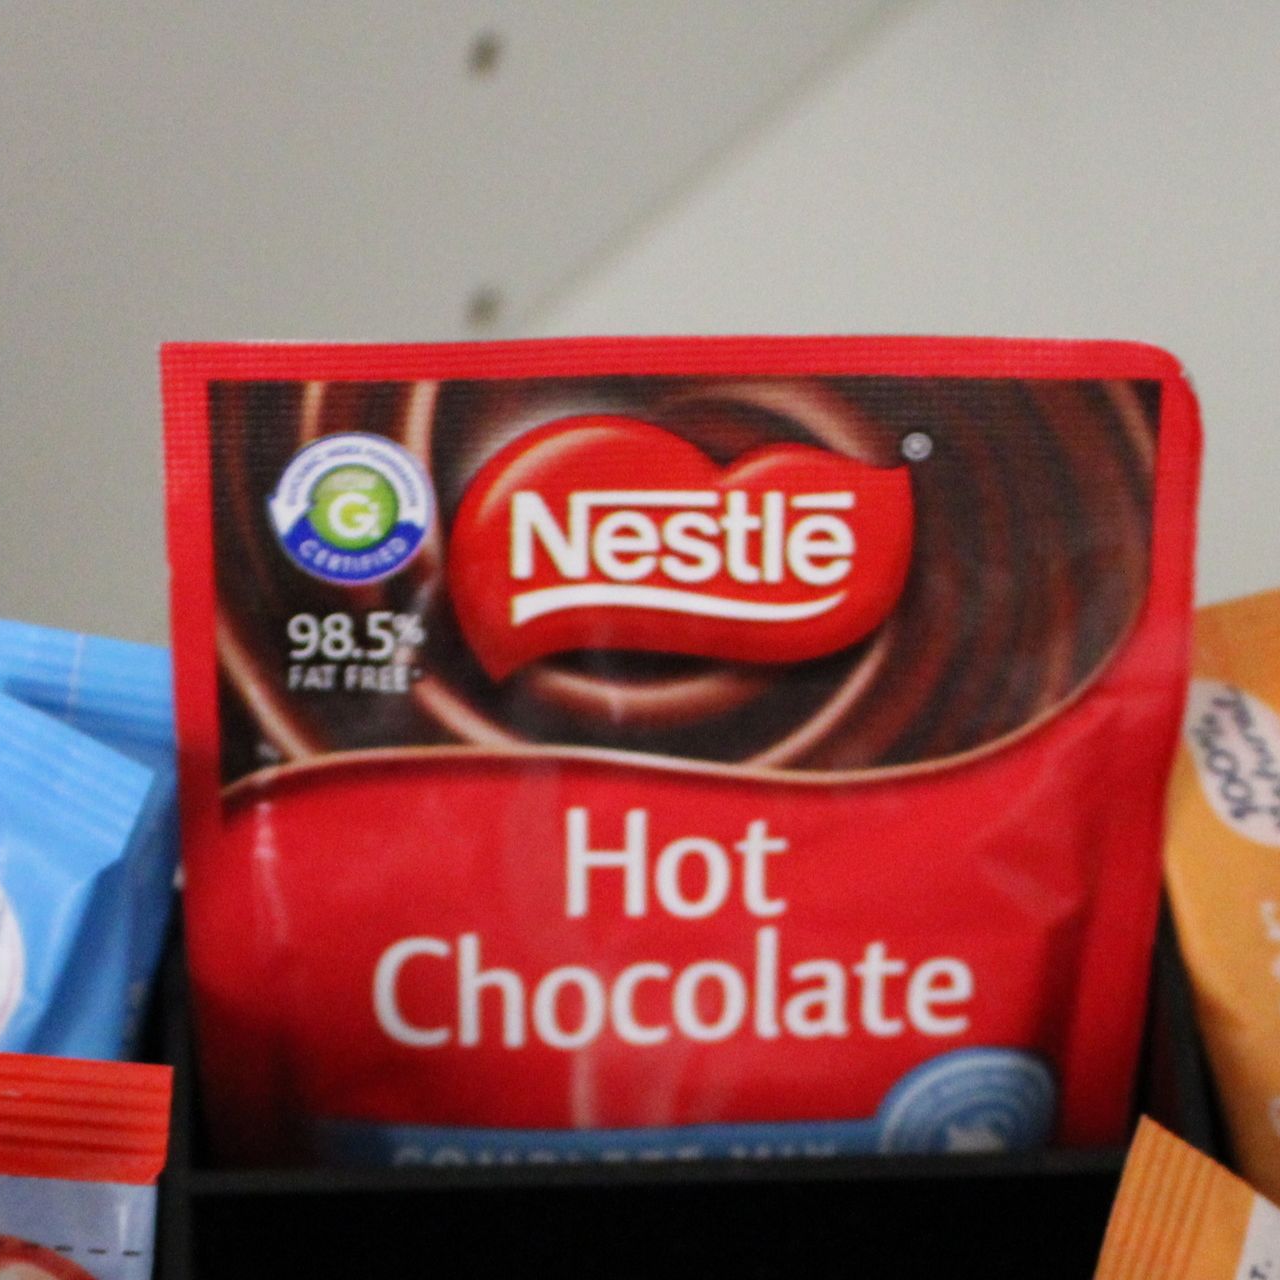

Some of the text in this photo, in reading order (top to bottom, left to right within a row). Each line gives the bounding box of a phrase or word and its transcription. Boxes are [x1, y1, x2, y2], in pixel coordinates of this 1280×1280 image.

[287, 611, 426, 659] 98.5%
[288, 664, 336, 689] FAT
[1191, 712, 1258, 820] 100%
[565, 807, 788, 920] Hot
[372, 926, 973, 1049] Chocolate
